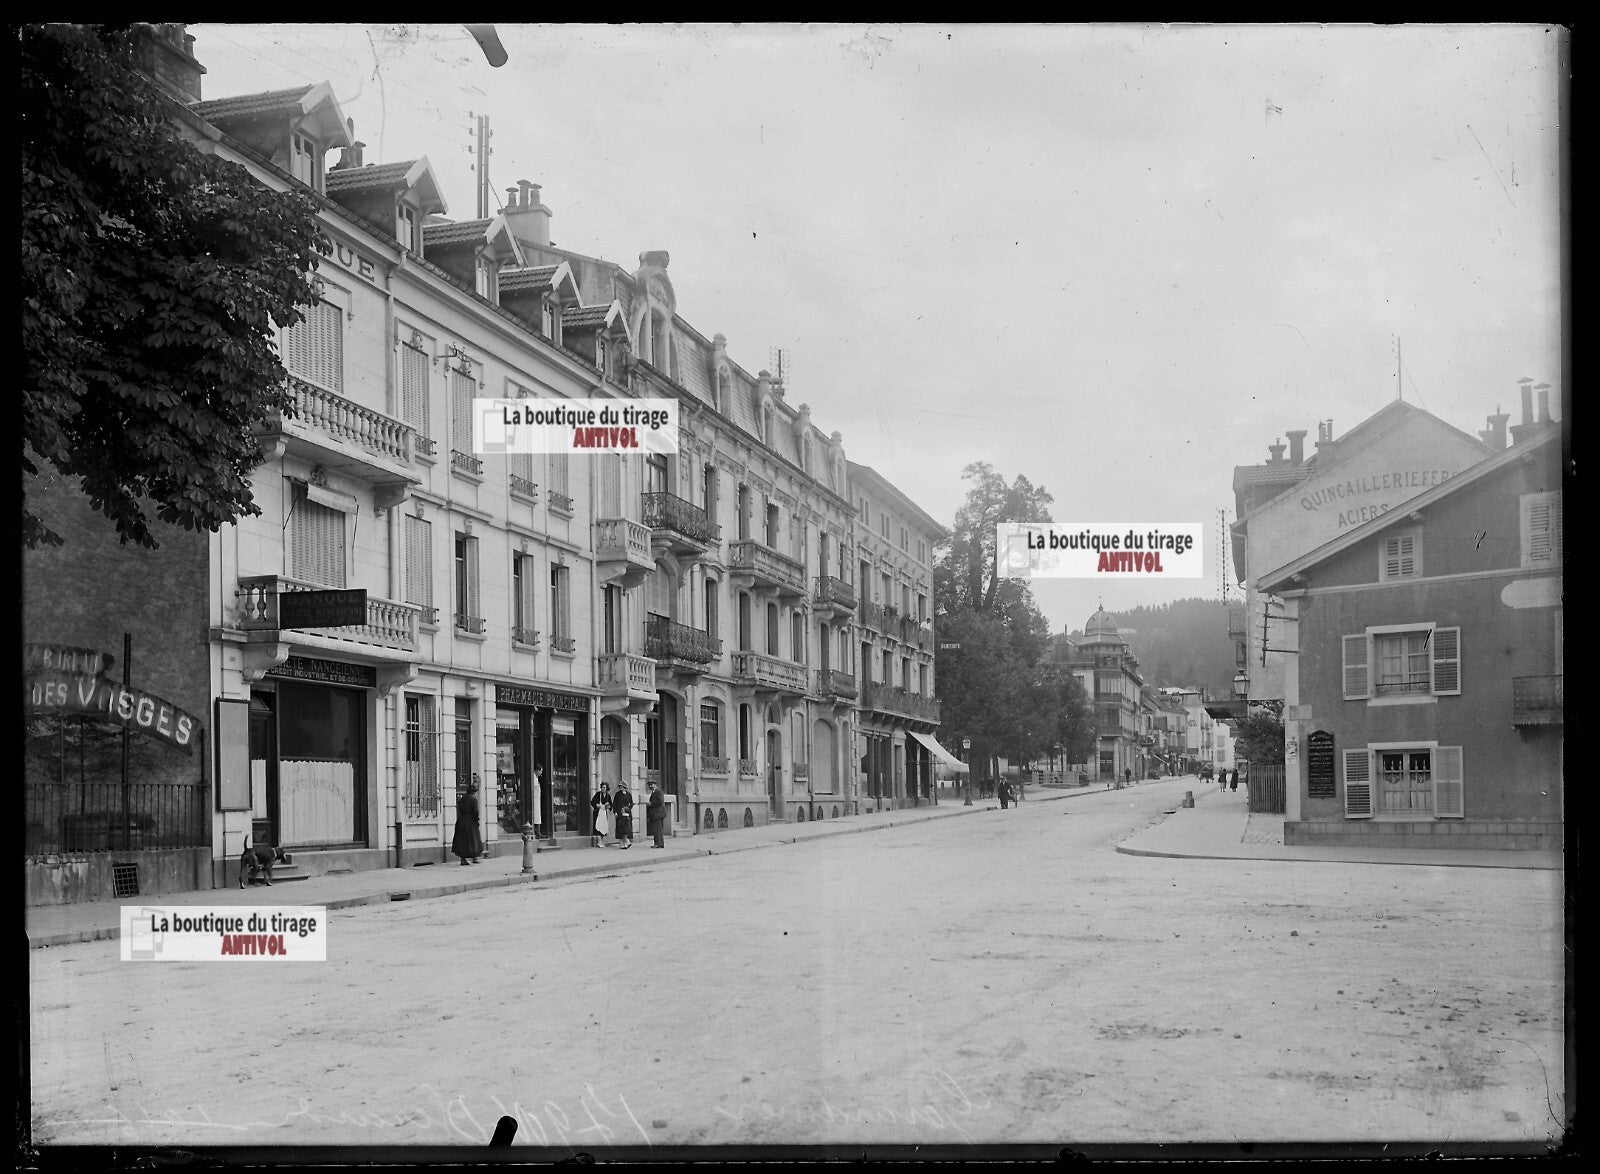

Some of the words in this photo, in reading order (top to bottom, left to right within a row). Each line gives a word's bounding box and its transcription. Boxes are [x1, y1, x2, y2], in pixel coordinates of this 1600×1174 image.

[1300, 472, 1418, 511] QUINCAILLERIE
[294, 669, 329, 680] INDUSTRIEL
[330, 674, 338, 682] ET
[32, 682, 68, 706] DES
[78, 678, 192, 745] VOSGES
[500, 687, 544, 705] PHARMACIE
[546, 693, 587, 710] PRINCIPALE
